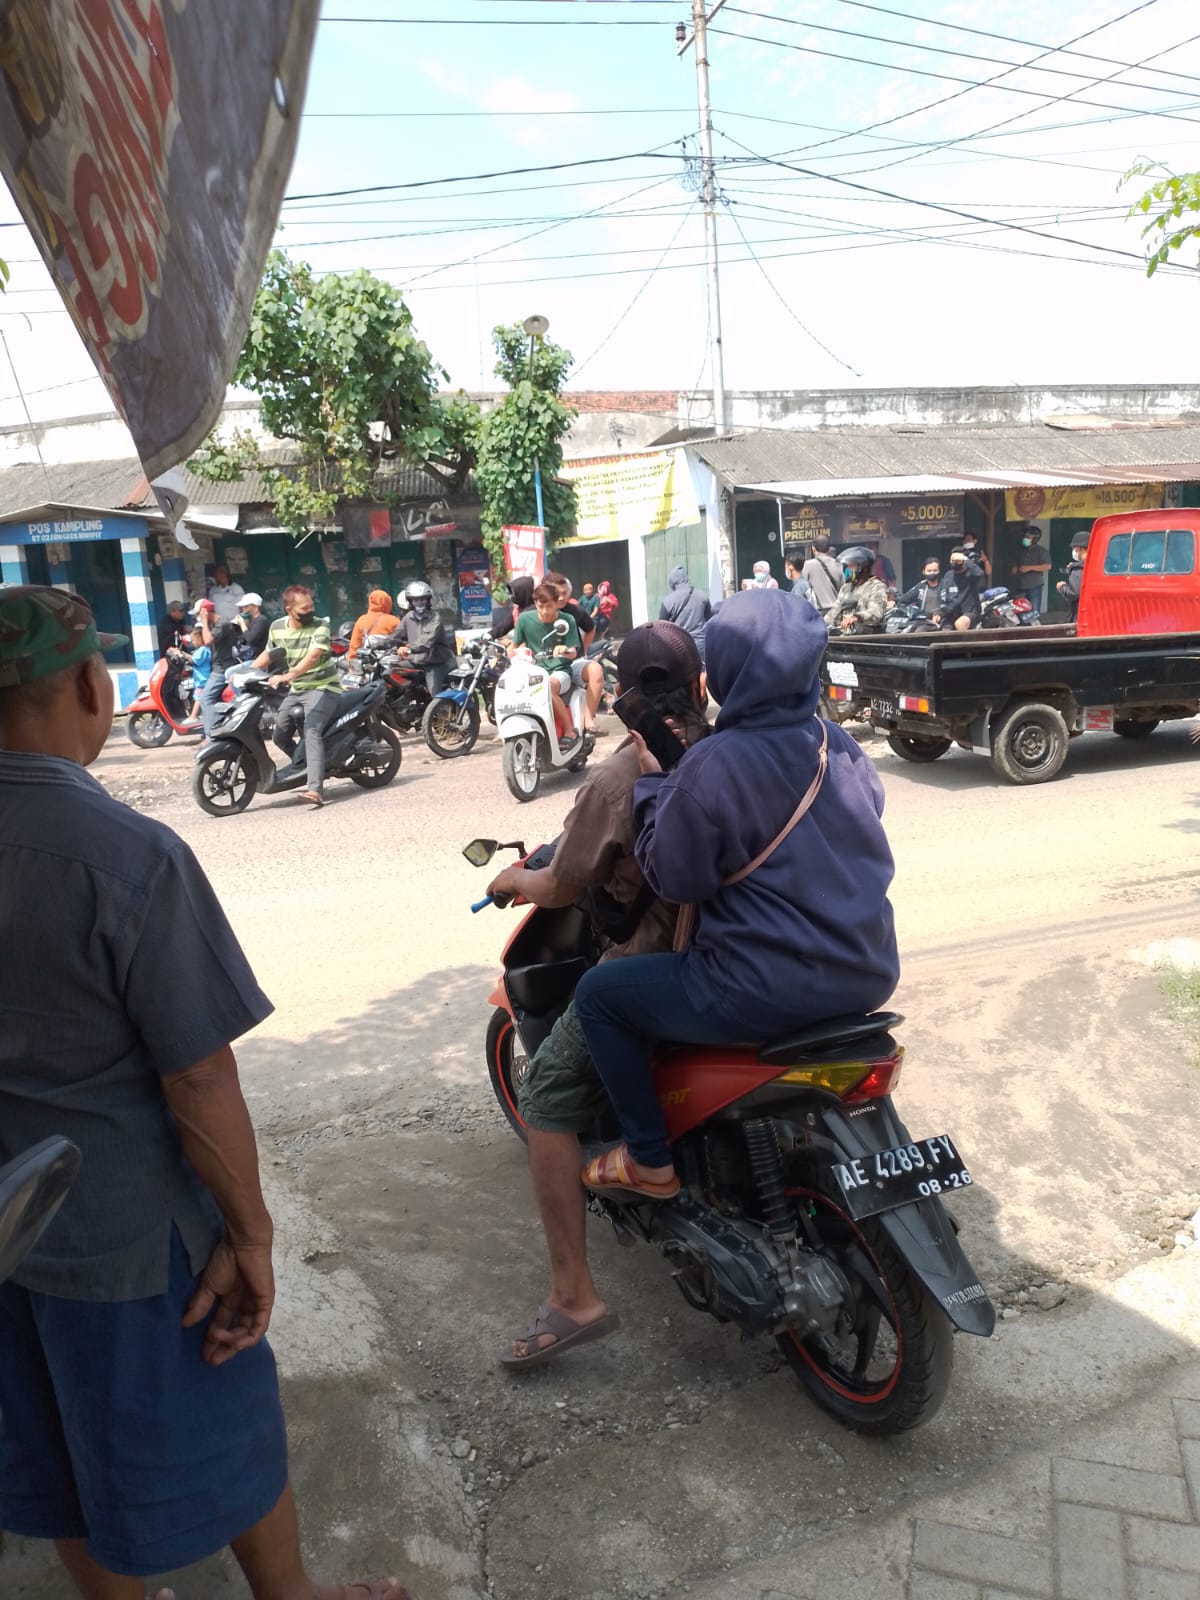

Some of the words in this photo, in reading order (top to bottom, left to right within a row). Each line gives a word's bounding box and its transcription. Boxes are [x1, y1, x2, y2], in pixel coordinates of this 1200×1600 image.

[28, 522, 51, 535] POS
[54, 520, 103, 533] KAMPLING
[791, 519, 824, 530] SUPER
[784, 527, 831, 541] PREMIUM
[849, 1105, 877, 1117] HONDA
[839, 1158, 869, 1191] AE
[875, 1144, 925, 1178] 4289
[927, 1134, 956, 1164] FY
